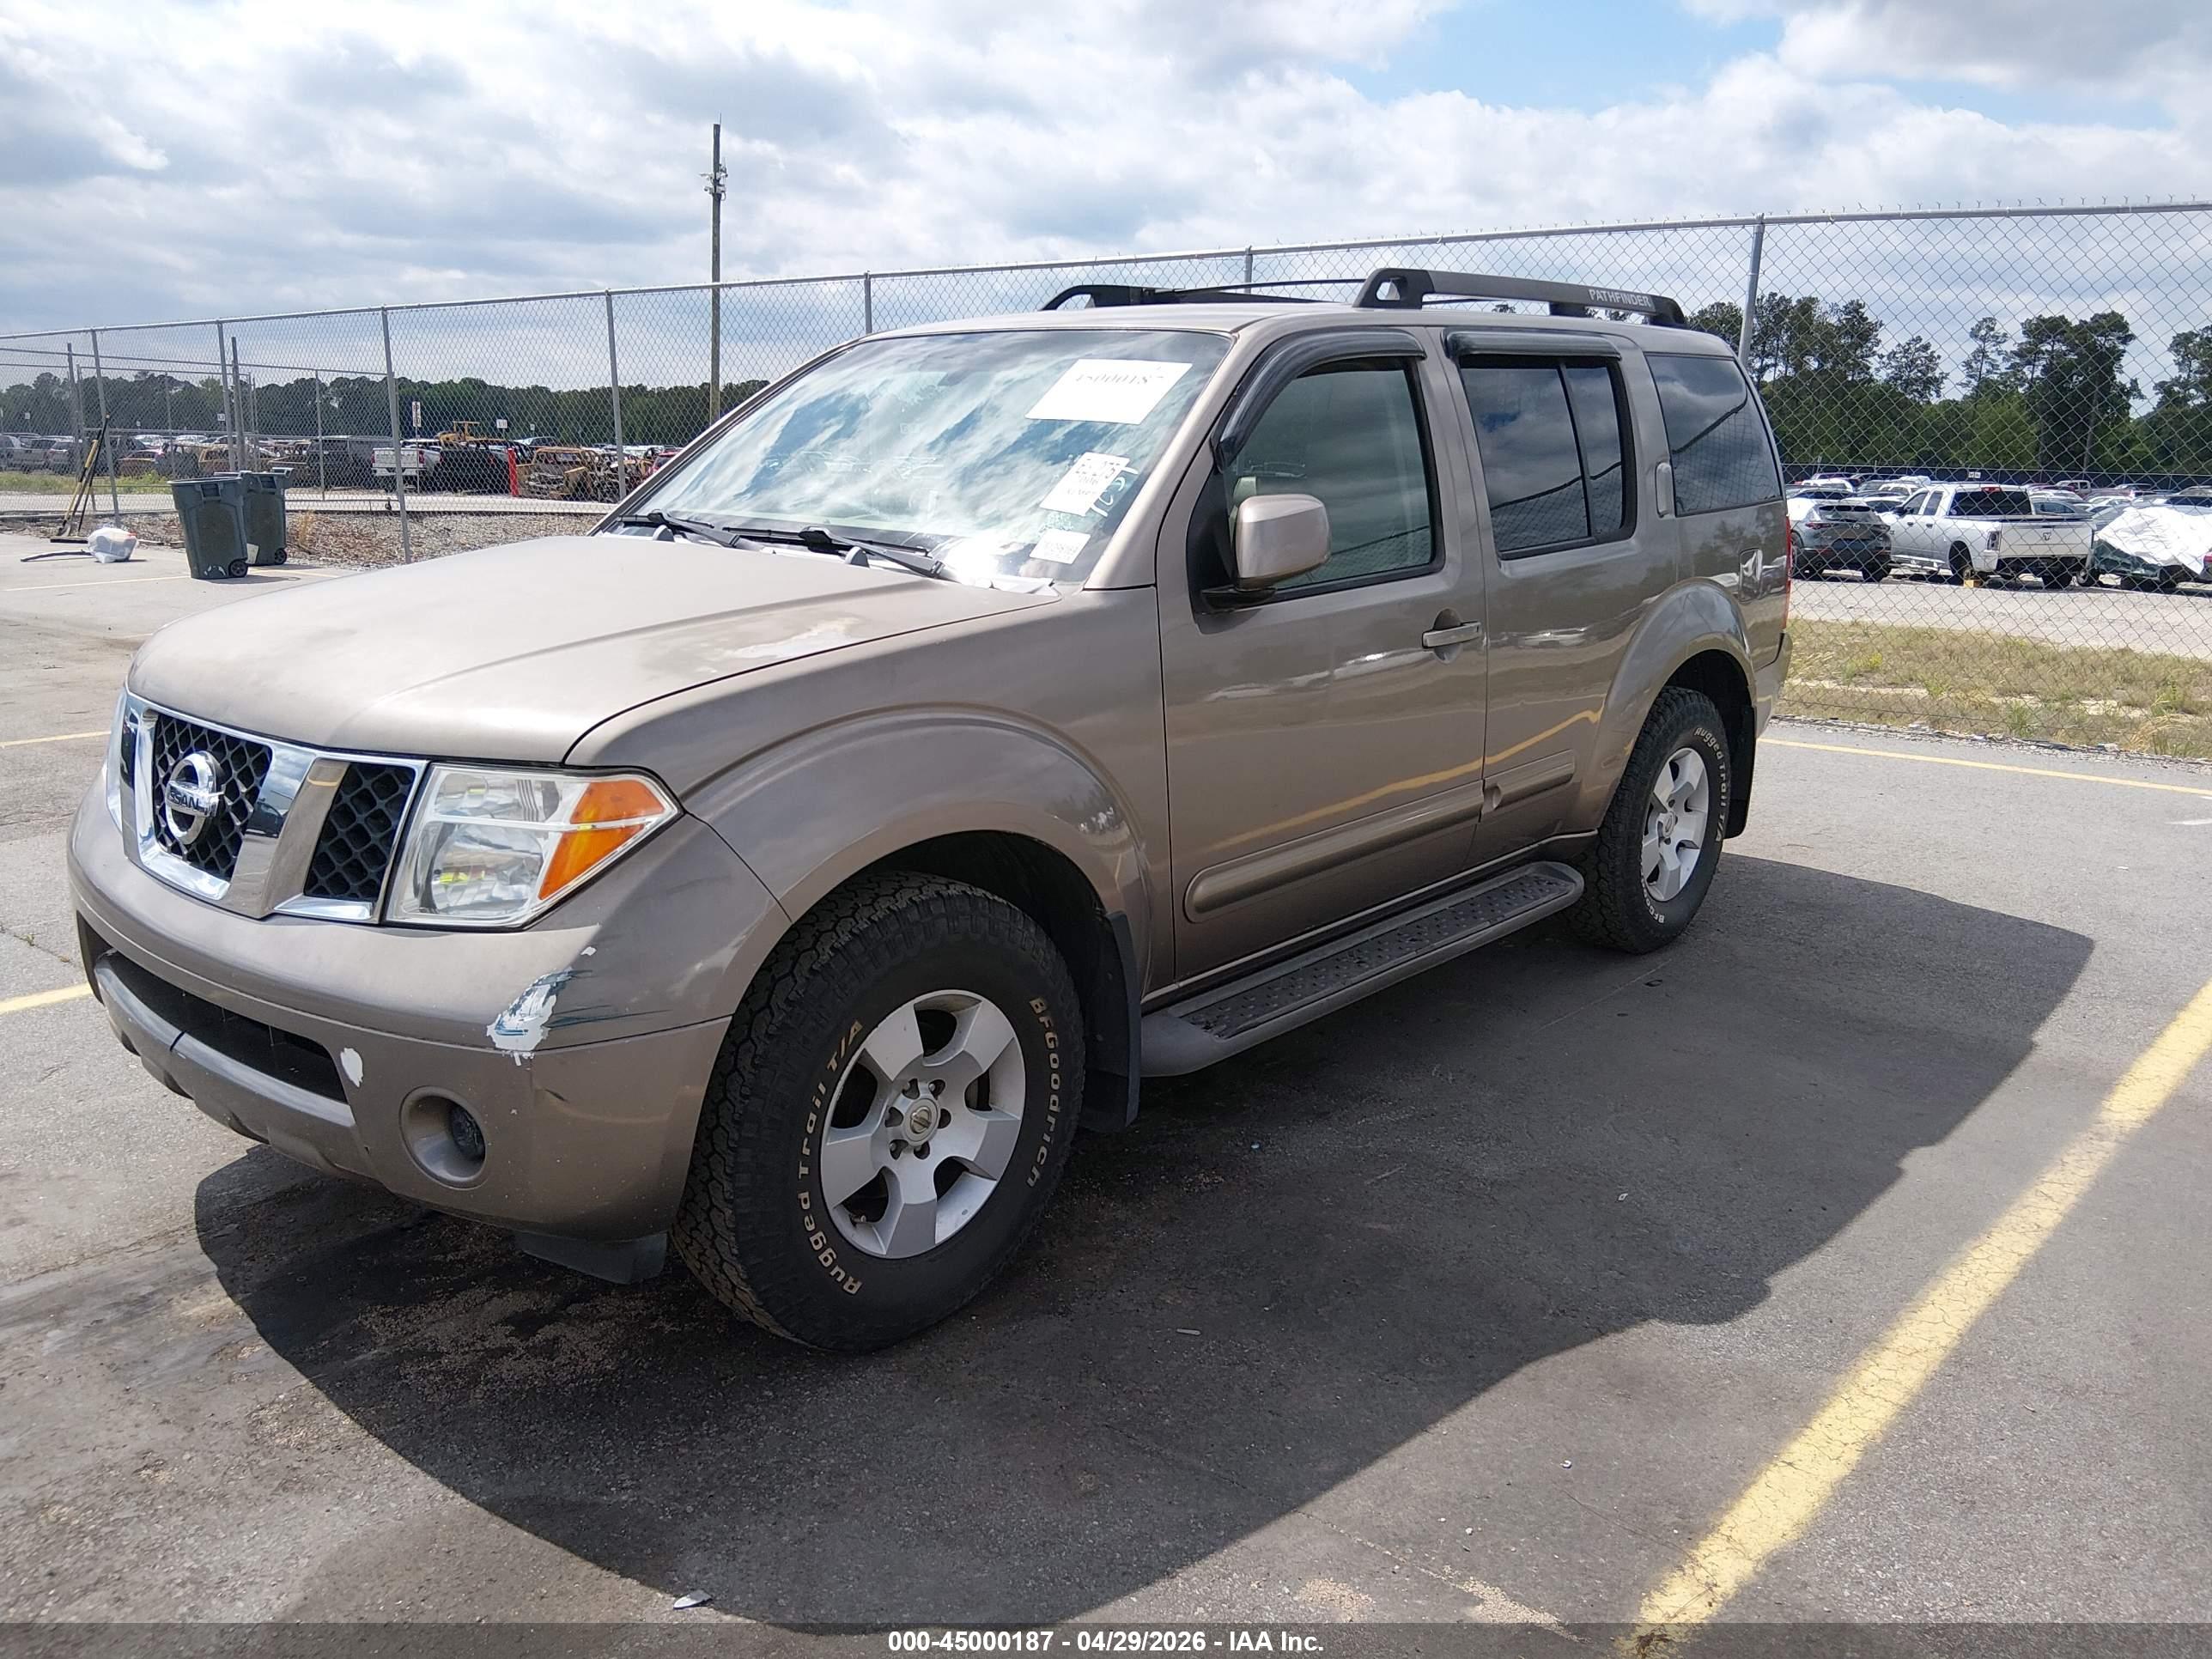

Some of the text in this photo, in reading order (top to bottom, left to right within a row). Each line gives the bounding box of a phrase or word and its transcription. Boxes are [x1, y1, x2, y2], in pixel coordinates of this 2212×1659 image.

[1588, 289, 1651, 307] PATHFINDER
[1694, 726, 1728, 842] Rugged Trail T/A
[797, 1019, 864, 1296] Rugged Trail T/A
[1027, 997, 1061, 1188] BFGoodrich
